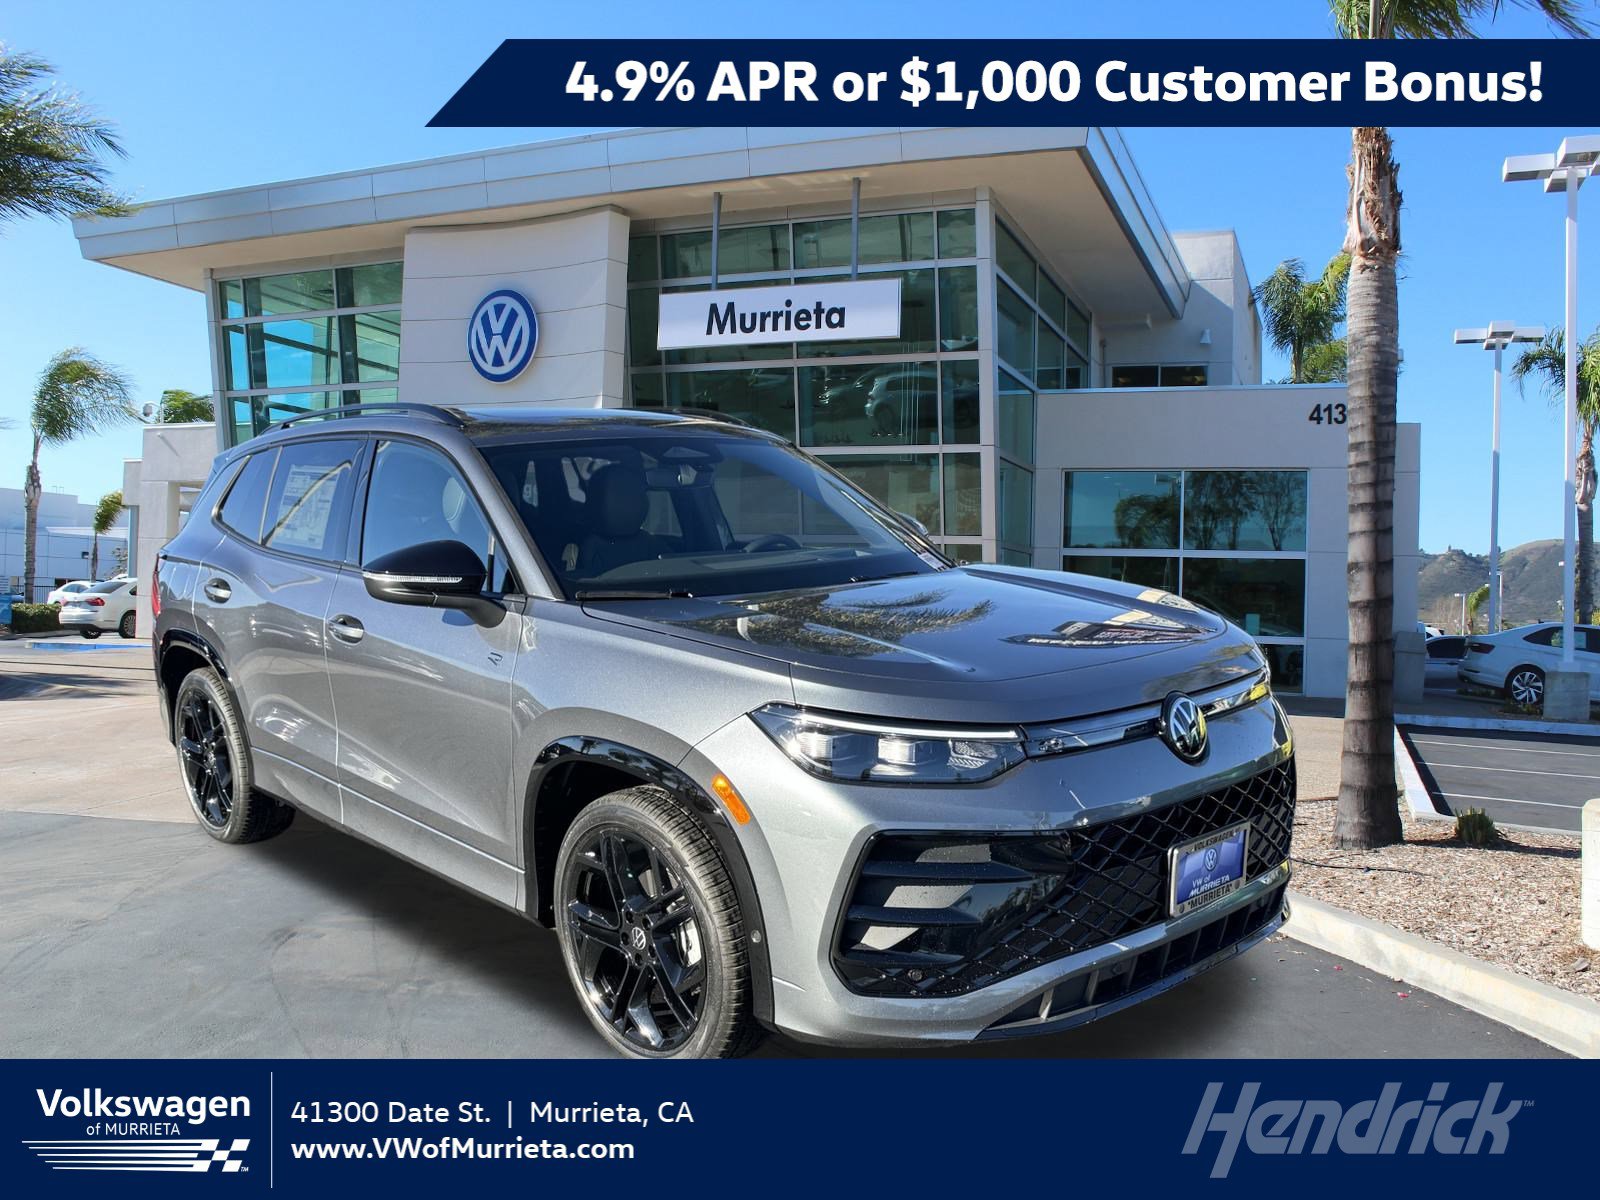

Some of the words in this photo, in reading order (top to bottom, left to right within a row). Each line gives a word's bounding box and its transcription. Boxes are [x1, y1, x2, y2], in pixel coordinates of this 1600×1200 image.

[706, 298, 846, 336] Murrieta
[1189, 874, 1230, 898] MURRIETA
[1192, 876, 1203, 889] VW
